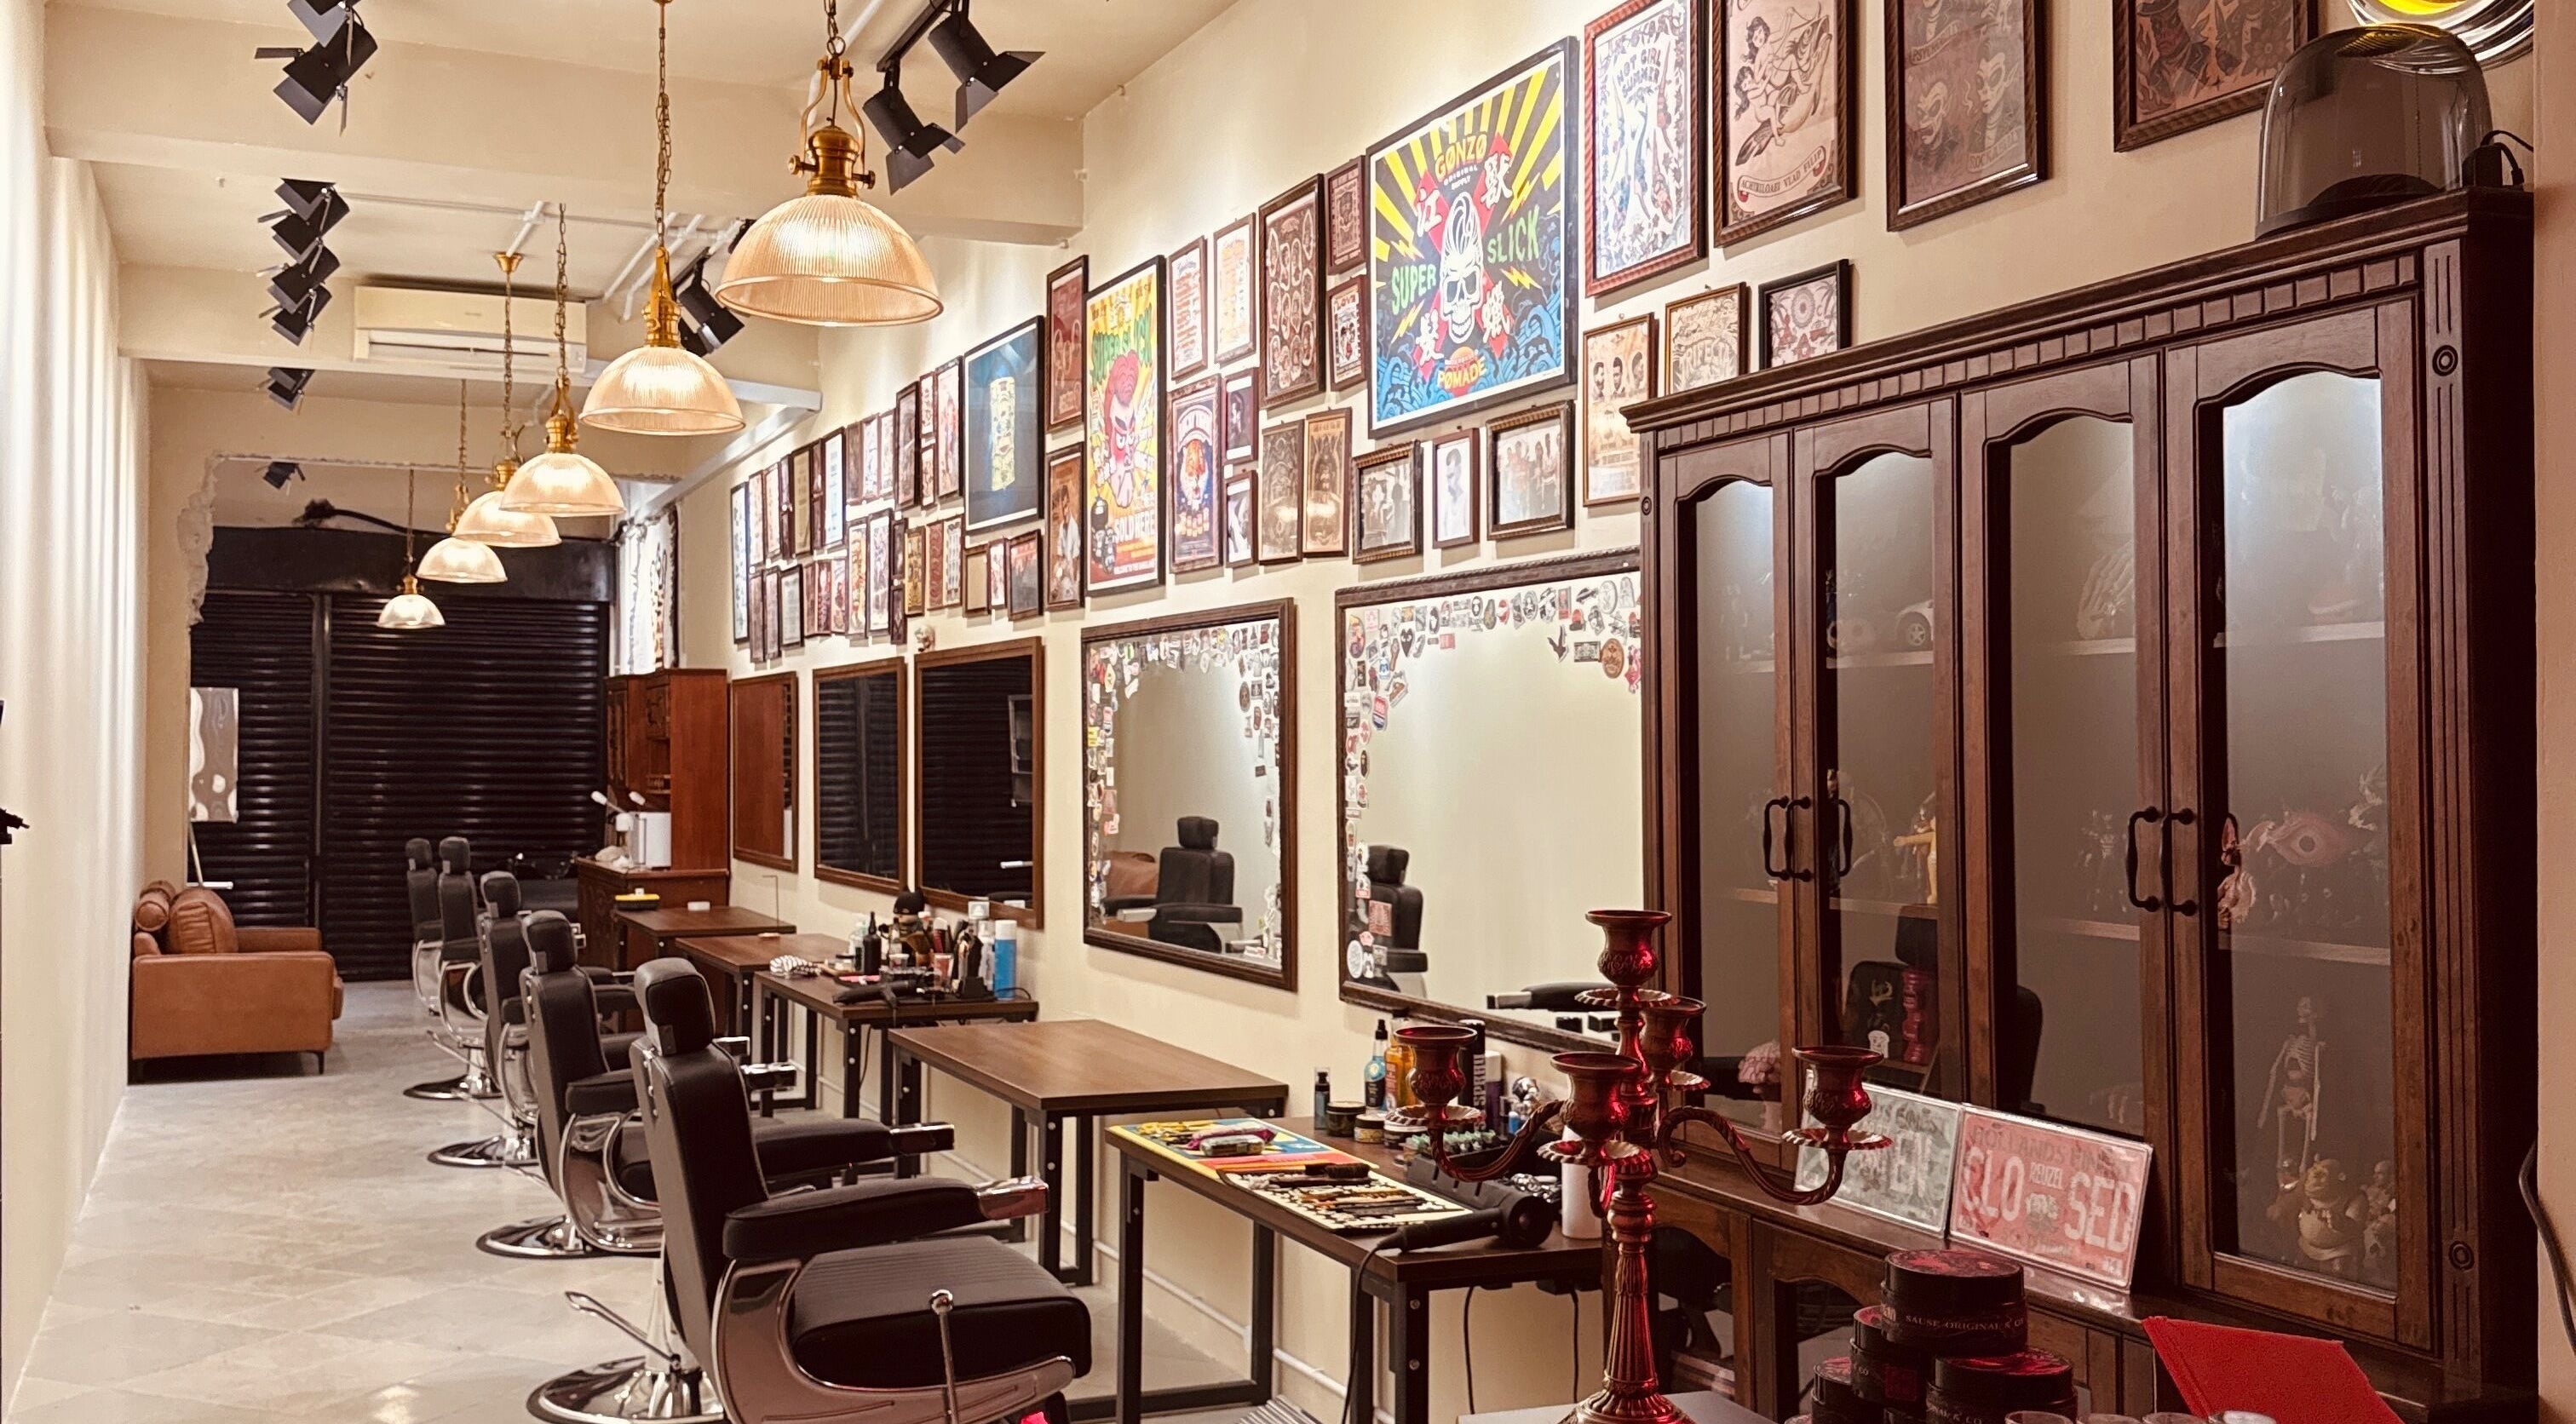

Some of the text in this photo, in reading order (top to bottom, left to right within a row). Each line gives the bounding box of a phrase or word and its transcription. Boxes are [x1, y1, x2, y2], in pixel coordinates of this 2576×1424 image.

[1641, 47, 1661, 67] GIRL
[1784, 170, 1802, 187] VLAD
[1803, 150, 1822, 173] FILIP
[1391, 207, 1540, 316] SUPER SLICK
[1114, 509, 1155, 543] SOLD HERE
